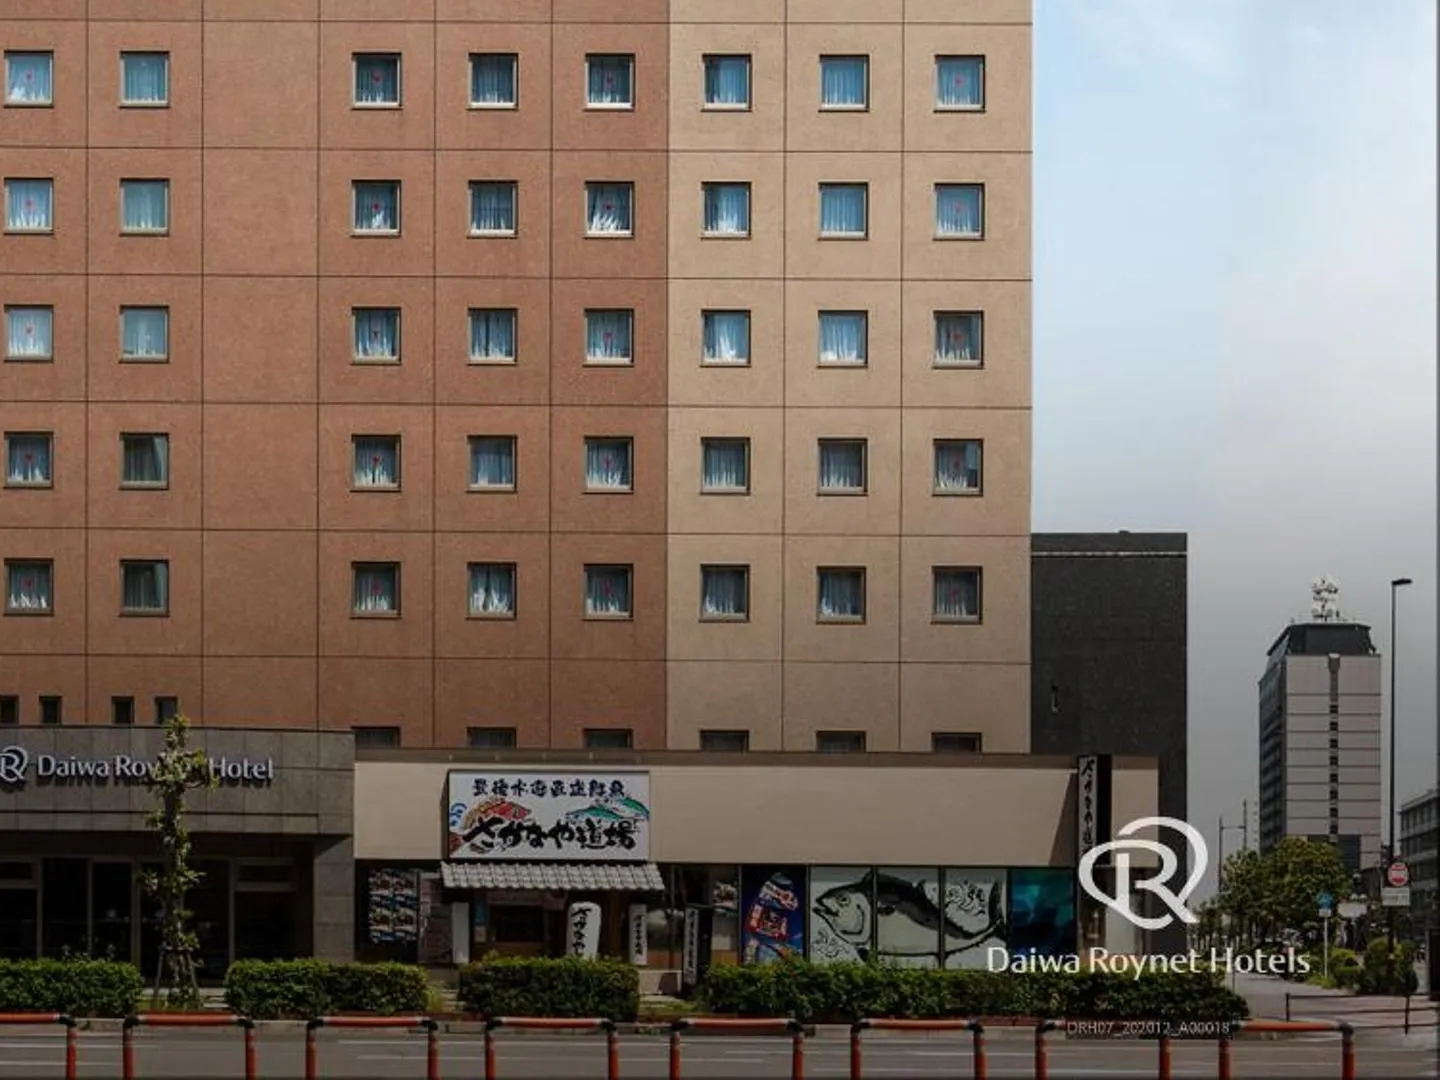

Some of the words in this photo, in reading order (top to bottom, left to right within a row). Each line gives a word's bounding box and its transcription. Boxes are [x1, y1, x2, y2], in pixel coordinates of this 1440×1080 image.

[37, 754, 110, 778] Daiwa
[209, 756, 275, 780] Hotel
[462, 816, 640, 850] さかなや道場
